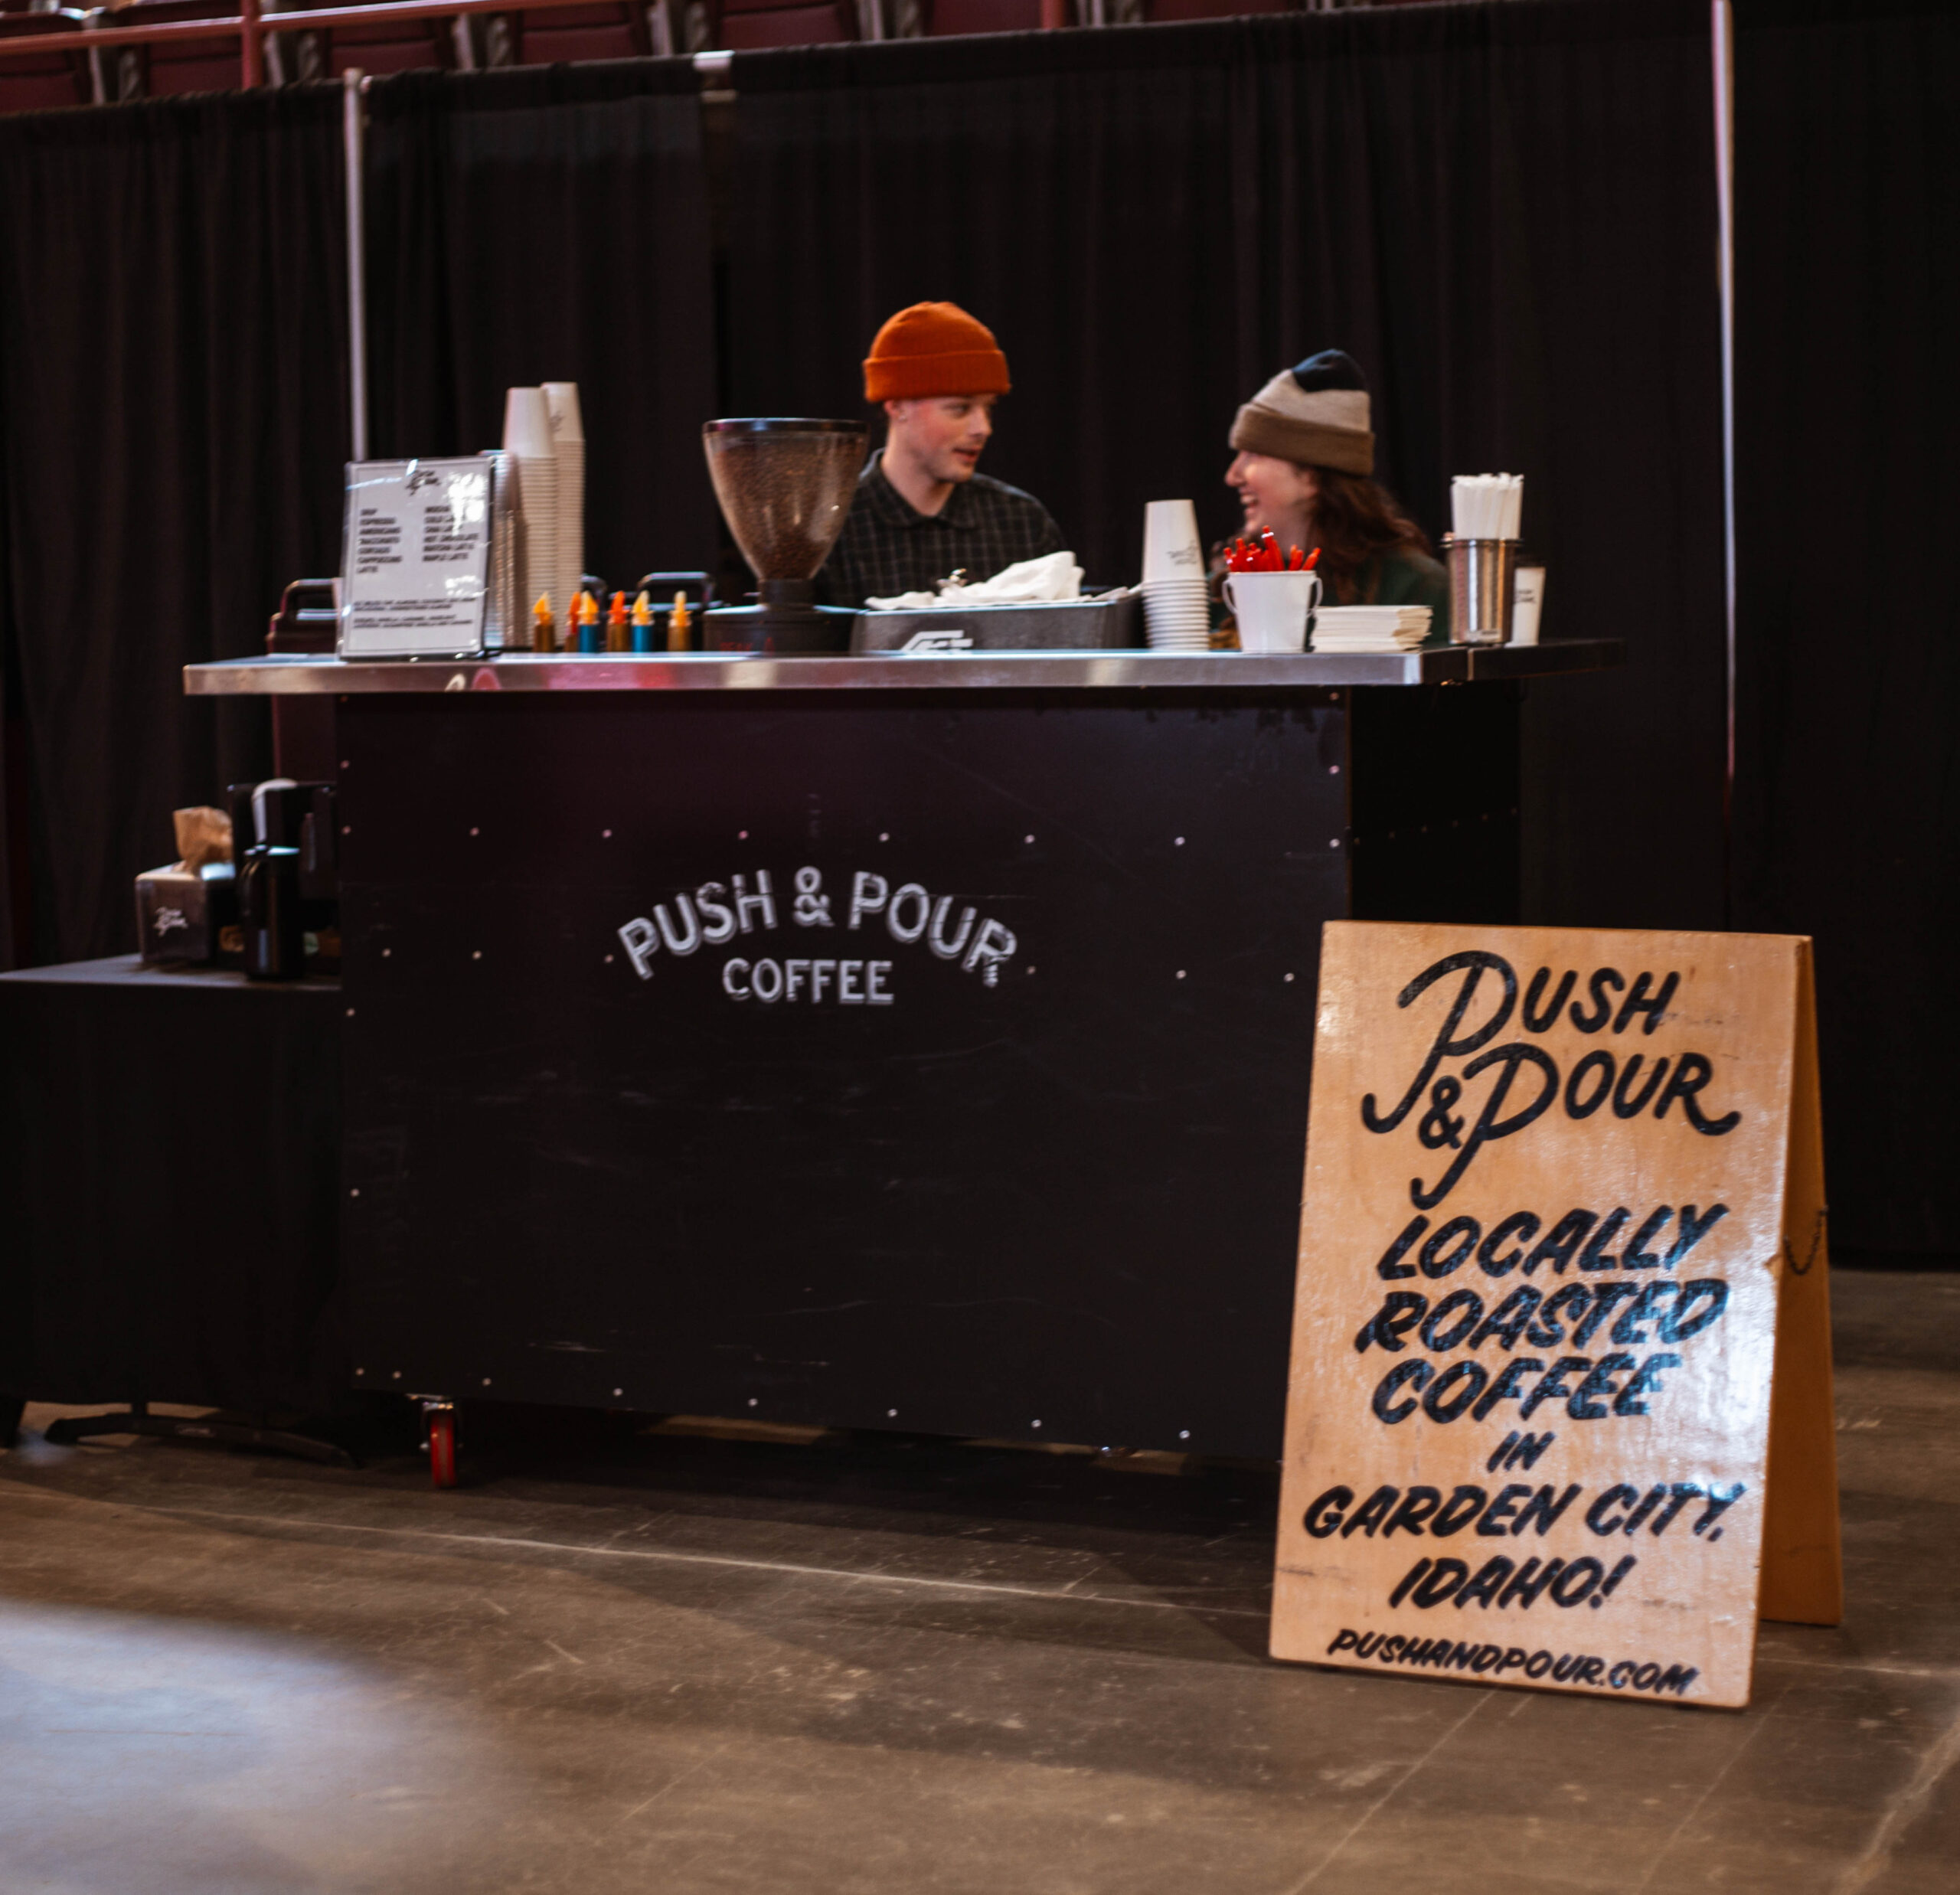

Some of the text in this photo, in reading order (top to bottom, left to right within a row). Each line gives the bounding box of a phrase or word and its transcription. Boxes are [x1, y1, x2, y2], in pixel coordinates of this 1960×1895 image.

[617, 866, 1018, 988] PUSH & POUR
[723, 958, 894, 1005] COFFEE
[1362, 950, 1681, 1134] PUSH
[1410, 1042, 1742, 1211] & POUR
[1377, 1203, 1730, 1281] LOCALLY
[1354, 1278, 1730, 1354] ROASTED
[1372, 1352, 1684, 1424] COFFEE
[1486, 1431, 1555, 1473] IN
[1304, 1482, 1583, 1539] GARDEN
[1388, 1554, 1637, 1609] IDAHO!
[1326, 1628, 1700, 1697] PUSHANDPOUR.COM
